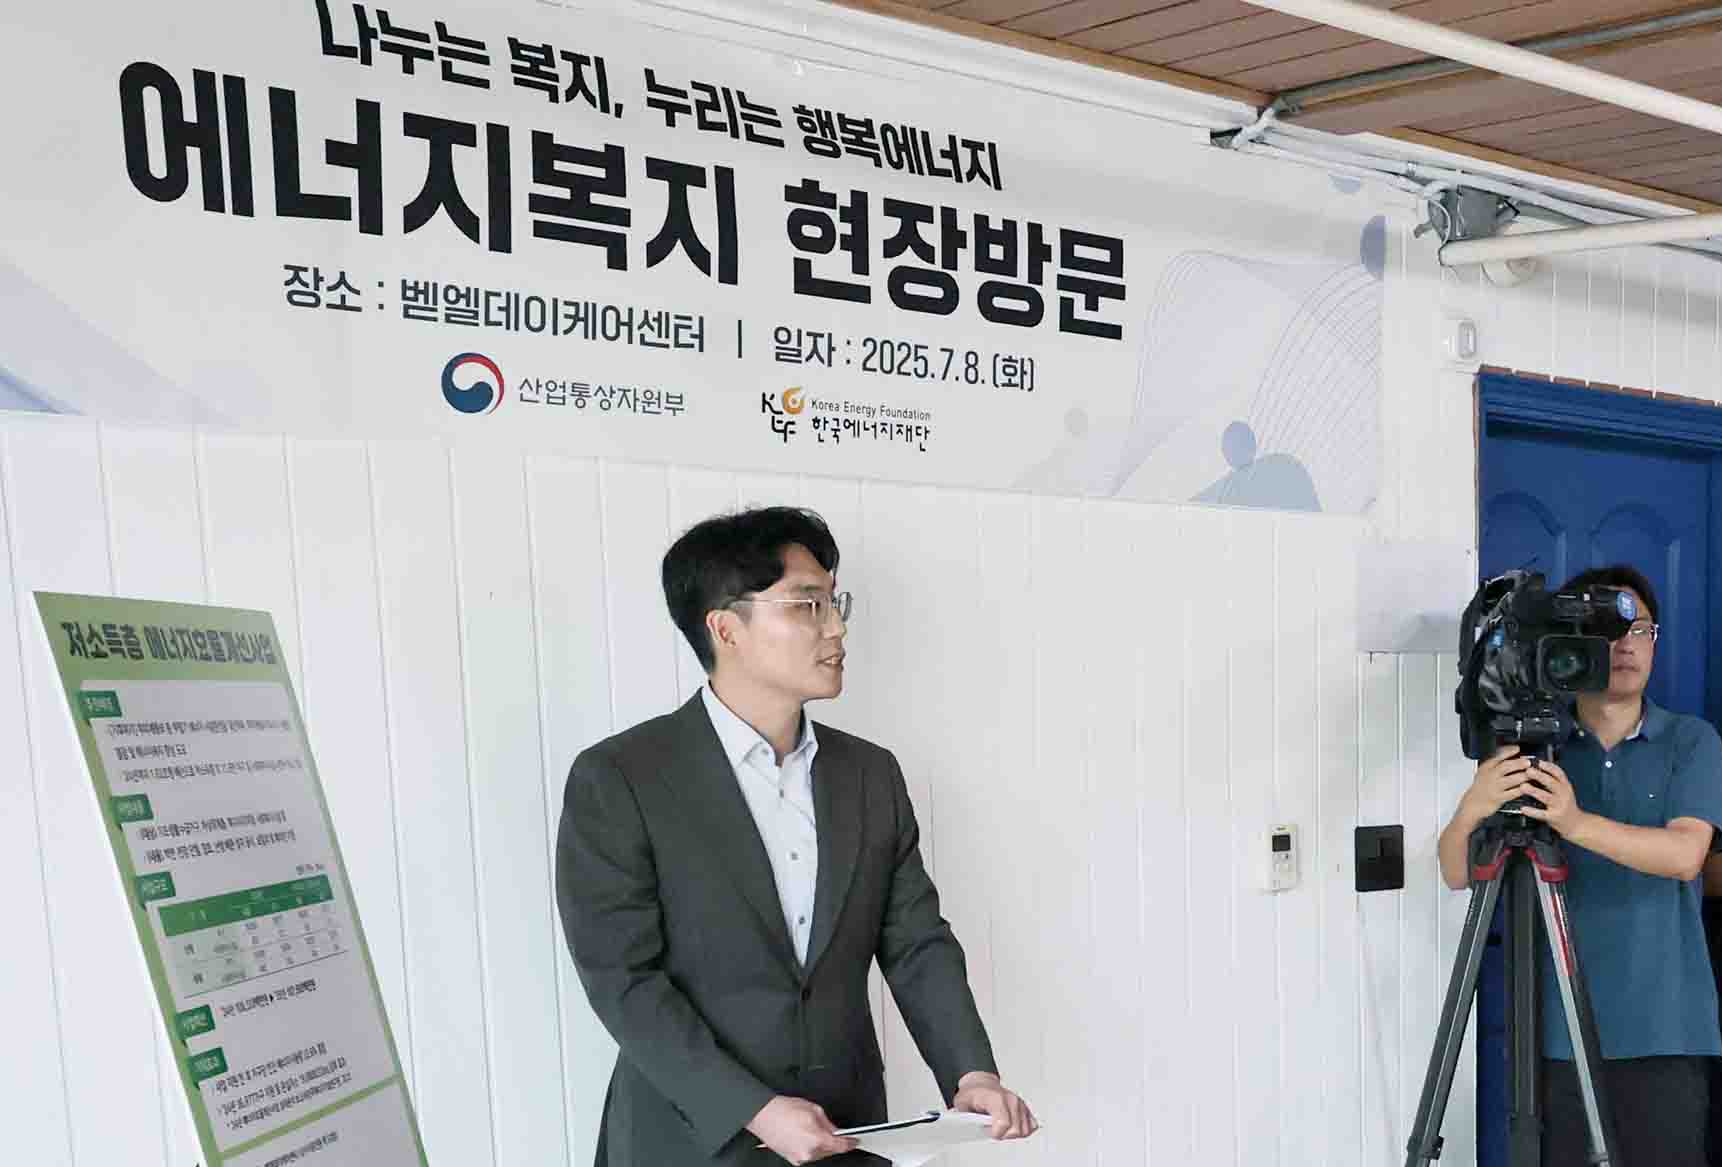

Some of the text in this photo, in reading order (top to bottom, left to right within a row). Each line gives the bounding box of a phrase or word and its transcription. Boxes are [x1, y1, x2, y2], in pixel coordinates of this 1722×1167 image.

[315, 0, 1004, 191] 나누는 복지, 누리는 행복에너지
[119, 61, 1126, 341] 에너지복지 현장방문
[283, 264, 363, 313] 장소
[400, 278, 705, 353] 벧엘데이케어센터
[773, 325, 837, 368] 일자
[519, 377, 685, 417] 산업통상자원부
[811, 399, 931, 421] Korea Energy Foundation
[811, 416, 931, 452] 한국에너지재단
